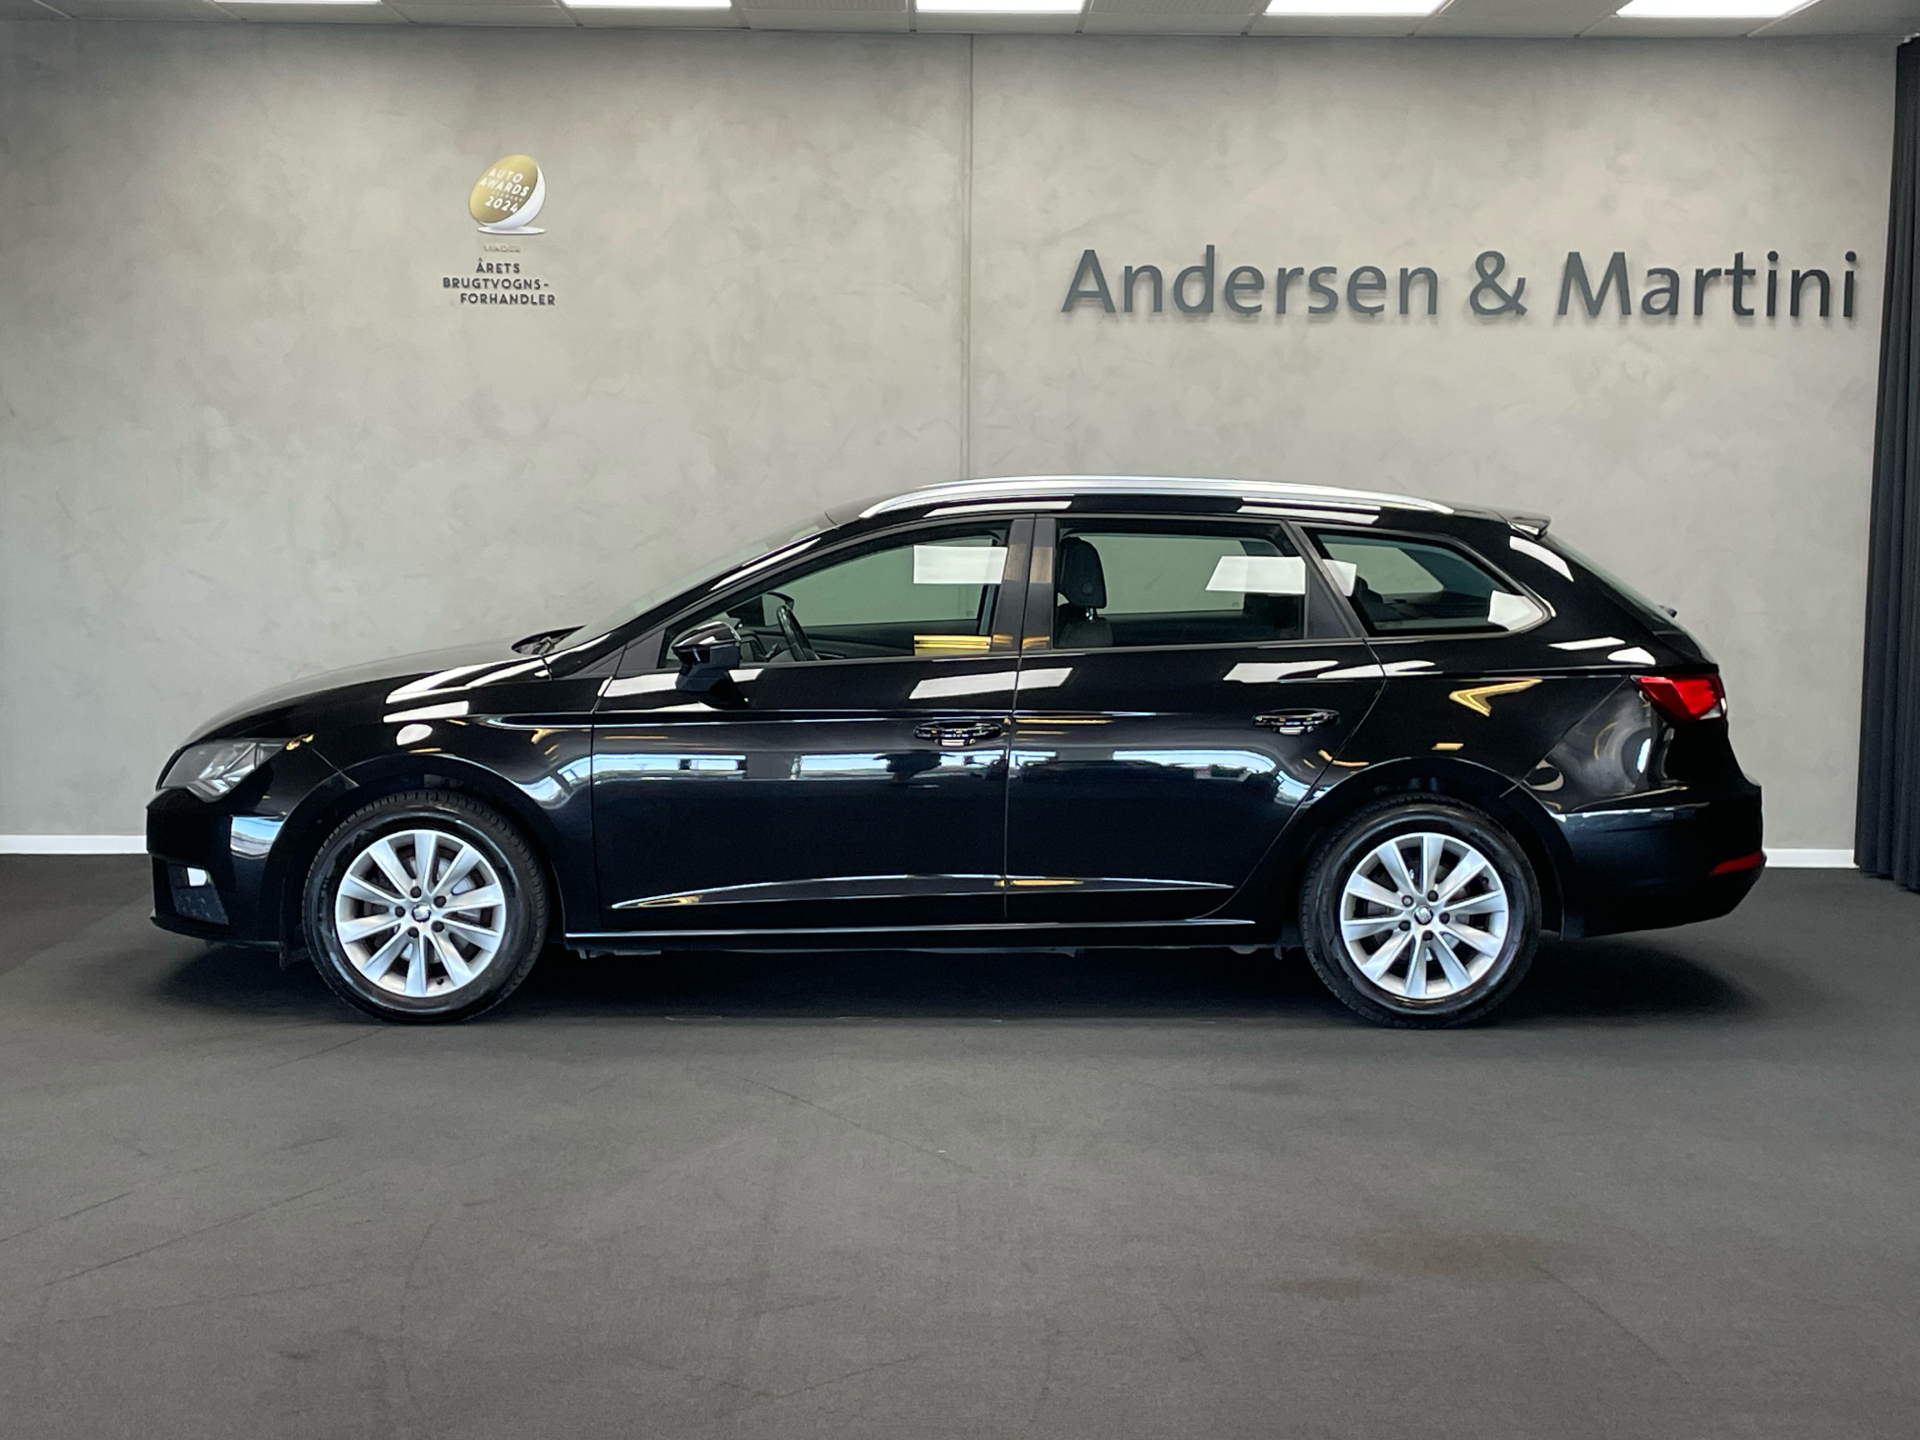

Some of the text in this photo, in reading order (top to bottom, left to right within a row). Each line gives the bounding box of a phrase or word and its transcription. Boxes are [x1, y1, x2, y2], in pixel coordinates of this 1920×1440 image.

[488, 168, 523, 183] AUTO
[480, 177, 530, 197] AWARDS
[485, 196, 518, 213] 2024
[476, 257, 520, 274] ÅRETS
[443, 277, 549, 290] BRUGTVOGNS-
[1061, 244, 1857, 317] Andersen & Martini
[460, 293, 555, 305] FORHANDLER
